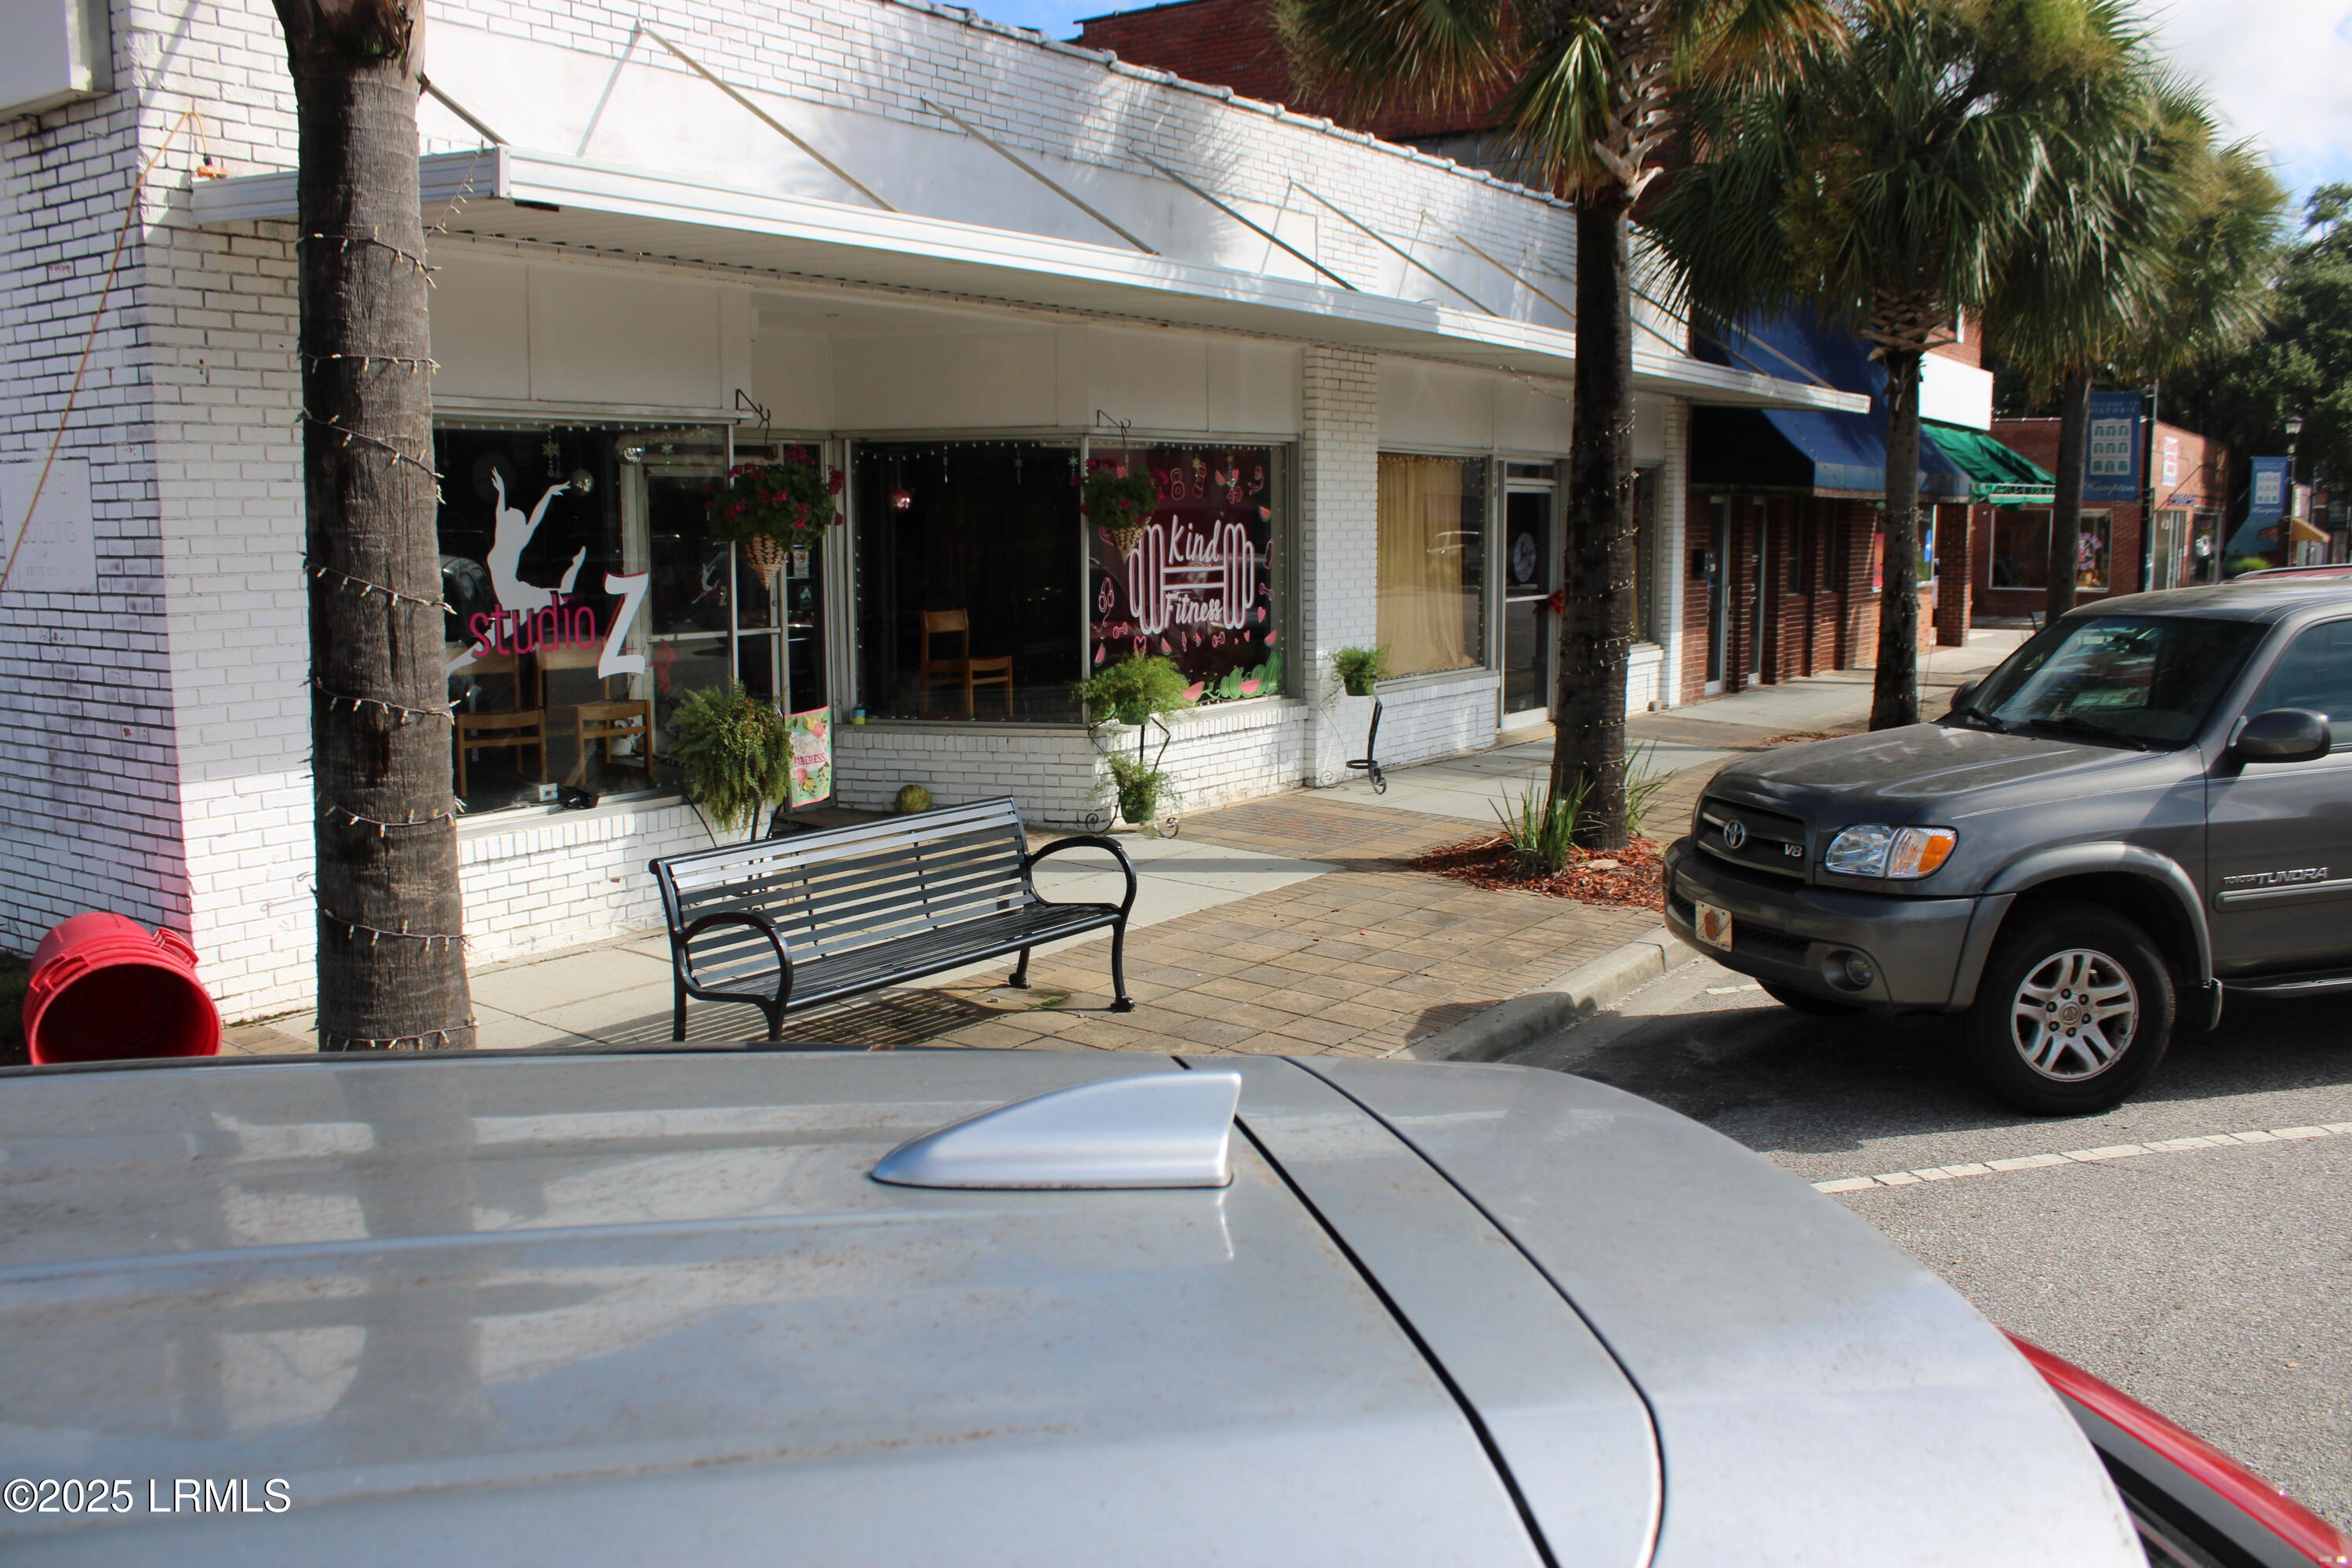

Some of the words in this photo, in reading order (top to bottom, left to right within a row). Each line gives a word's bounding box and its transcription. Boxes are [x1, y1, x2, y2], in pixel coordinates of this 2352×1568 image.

[470, 593, 596, 658] studio
[597, 571, 649, 679] Z
[1164, 593, 1223, 630] Fitness
[1784, 844, 1802, 857] V8
[2256, 867, 2329, 885] TUNDRA
